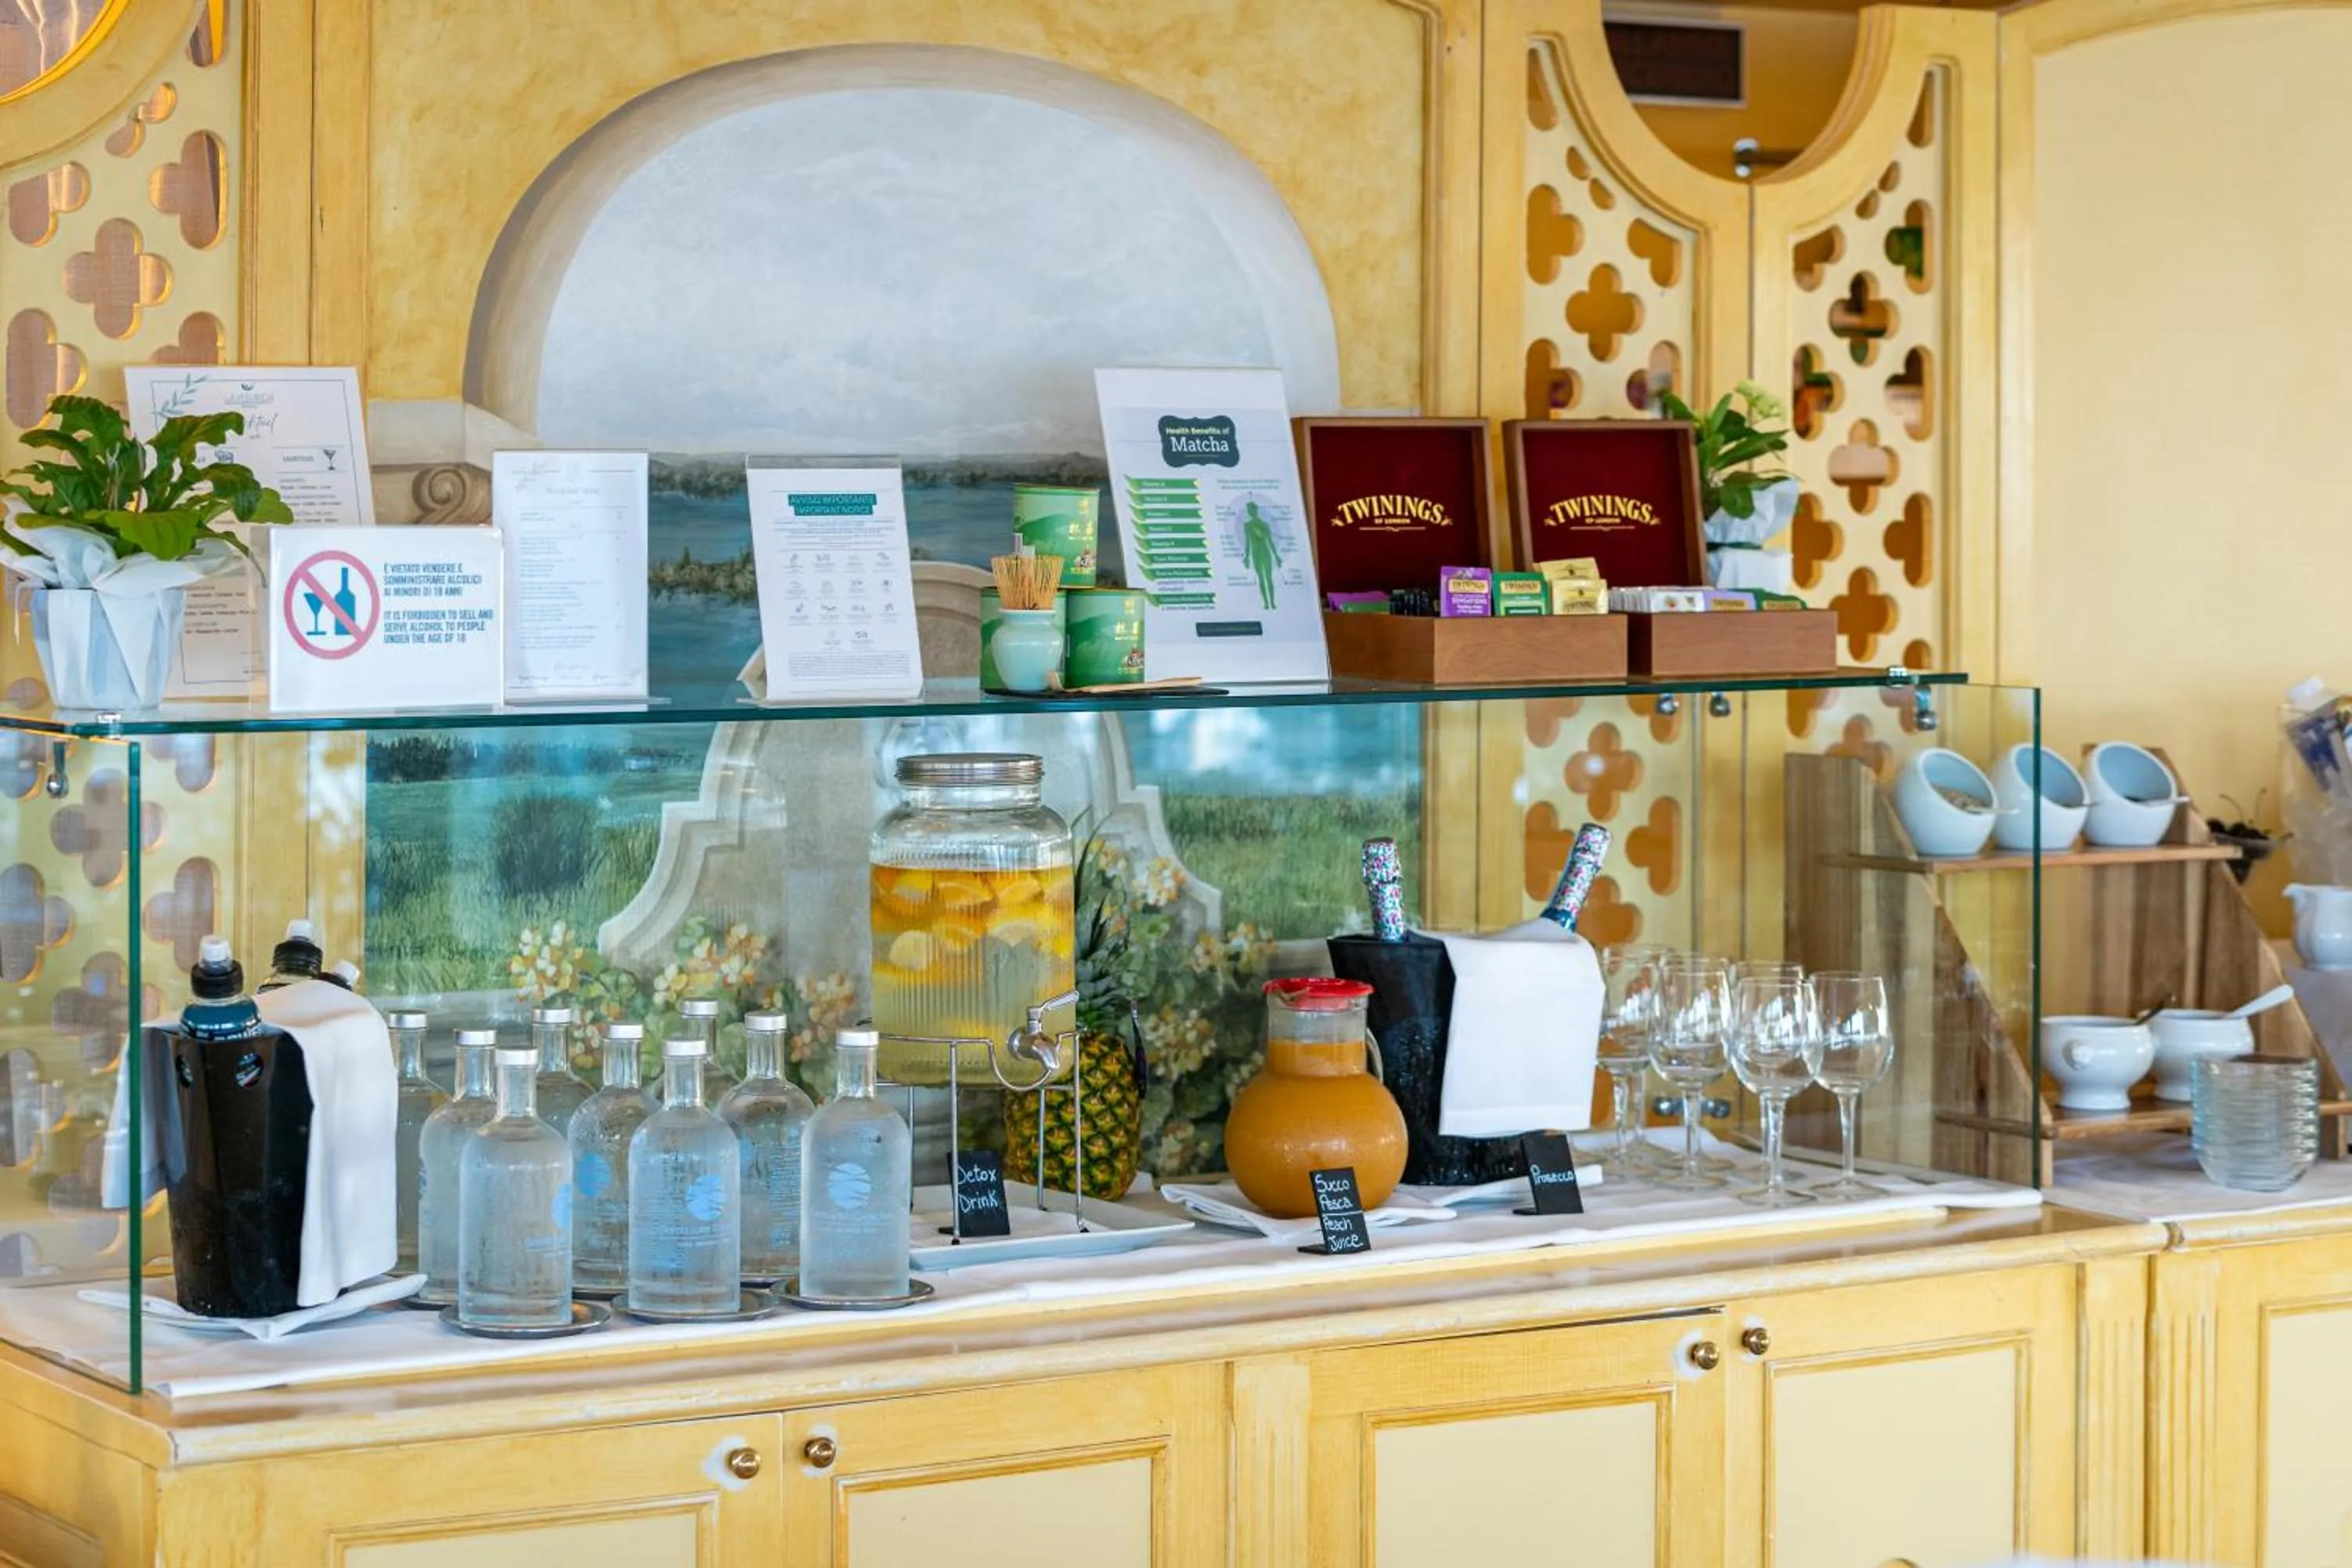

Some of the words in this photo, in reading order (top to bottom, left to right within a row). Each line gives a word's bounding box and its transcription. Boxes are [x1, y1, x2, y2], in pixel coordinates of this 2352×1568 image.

[1191, 426, 1221, 435] Benefits
[1171, 436, 1229, 452] Matcha
[1338, 495, 1445, 524] TWININGS
[1549, 495, 1653, 524] TWININGS
[459, 609, 477, 619] SELL
[477, 609, 493, 619] AND
[410, 622, 444, 631] ALCOHOL
[445, 621, 455, 630] TO
[427, 633, 443, 643] AGE
[445, 633, 455, 642] OF
[956, 1164, 996, 1185] Detox
[1530, 1164, 1574, 1185] Prosecco
[958, 1190, 998, 1214] Drink
[1319, 1194, 1354, 1211] Pesca
[1322, 1214, 1353, 1231] Peach
[1328, 1234, 1364, 1252] Juice
